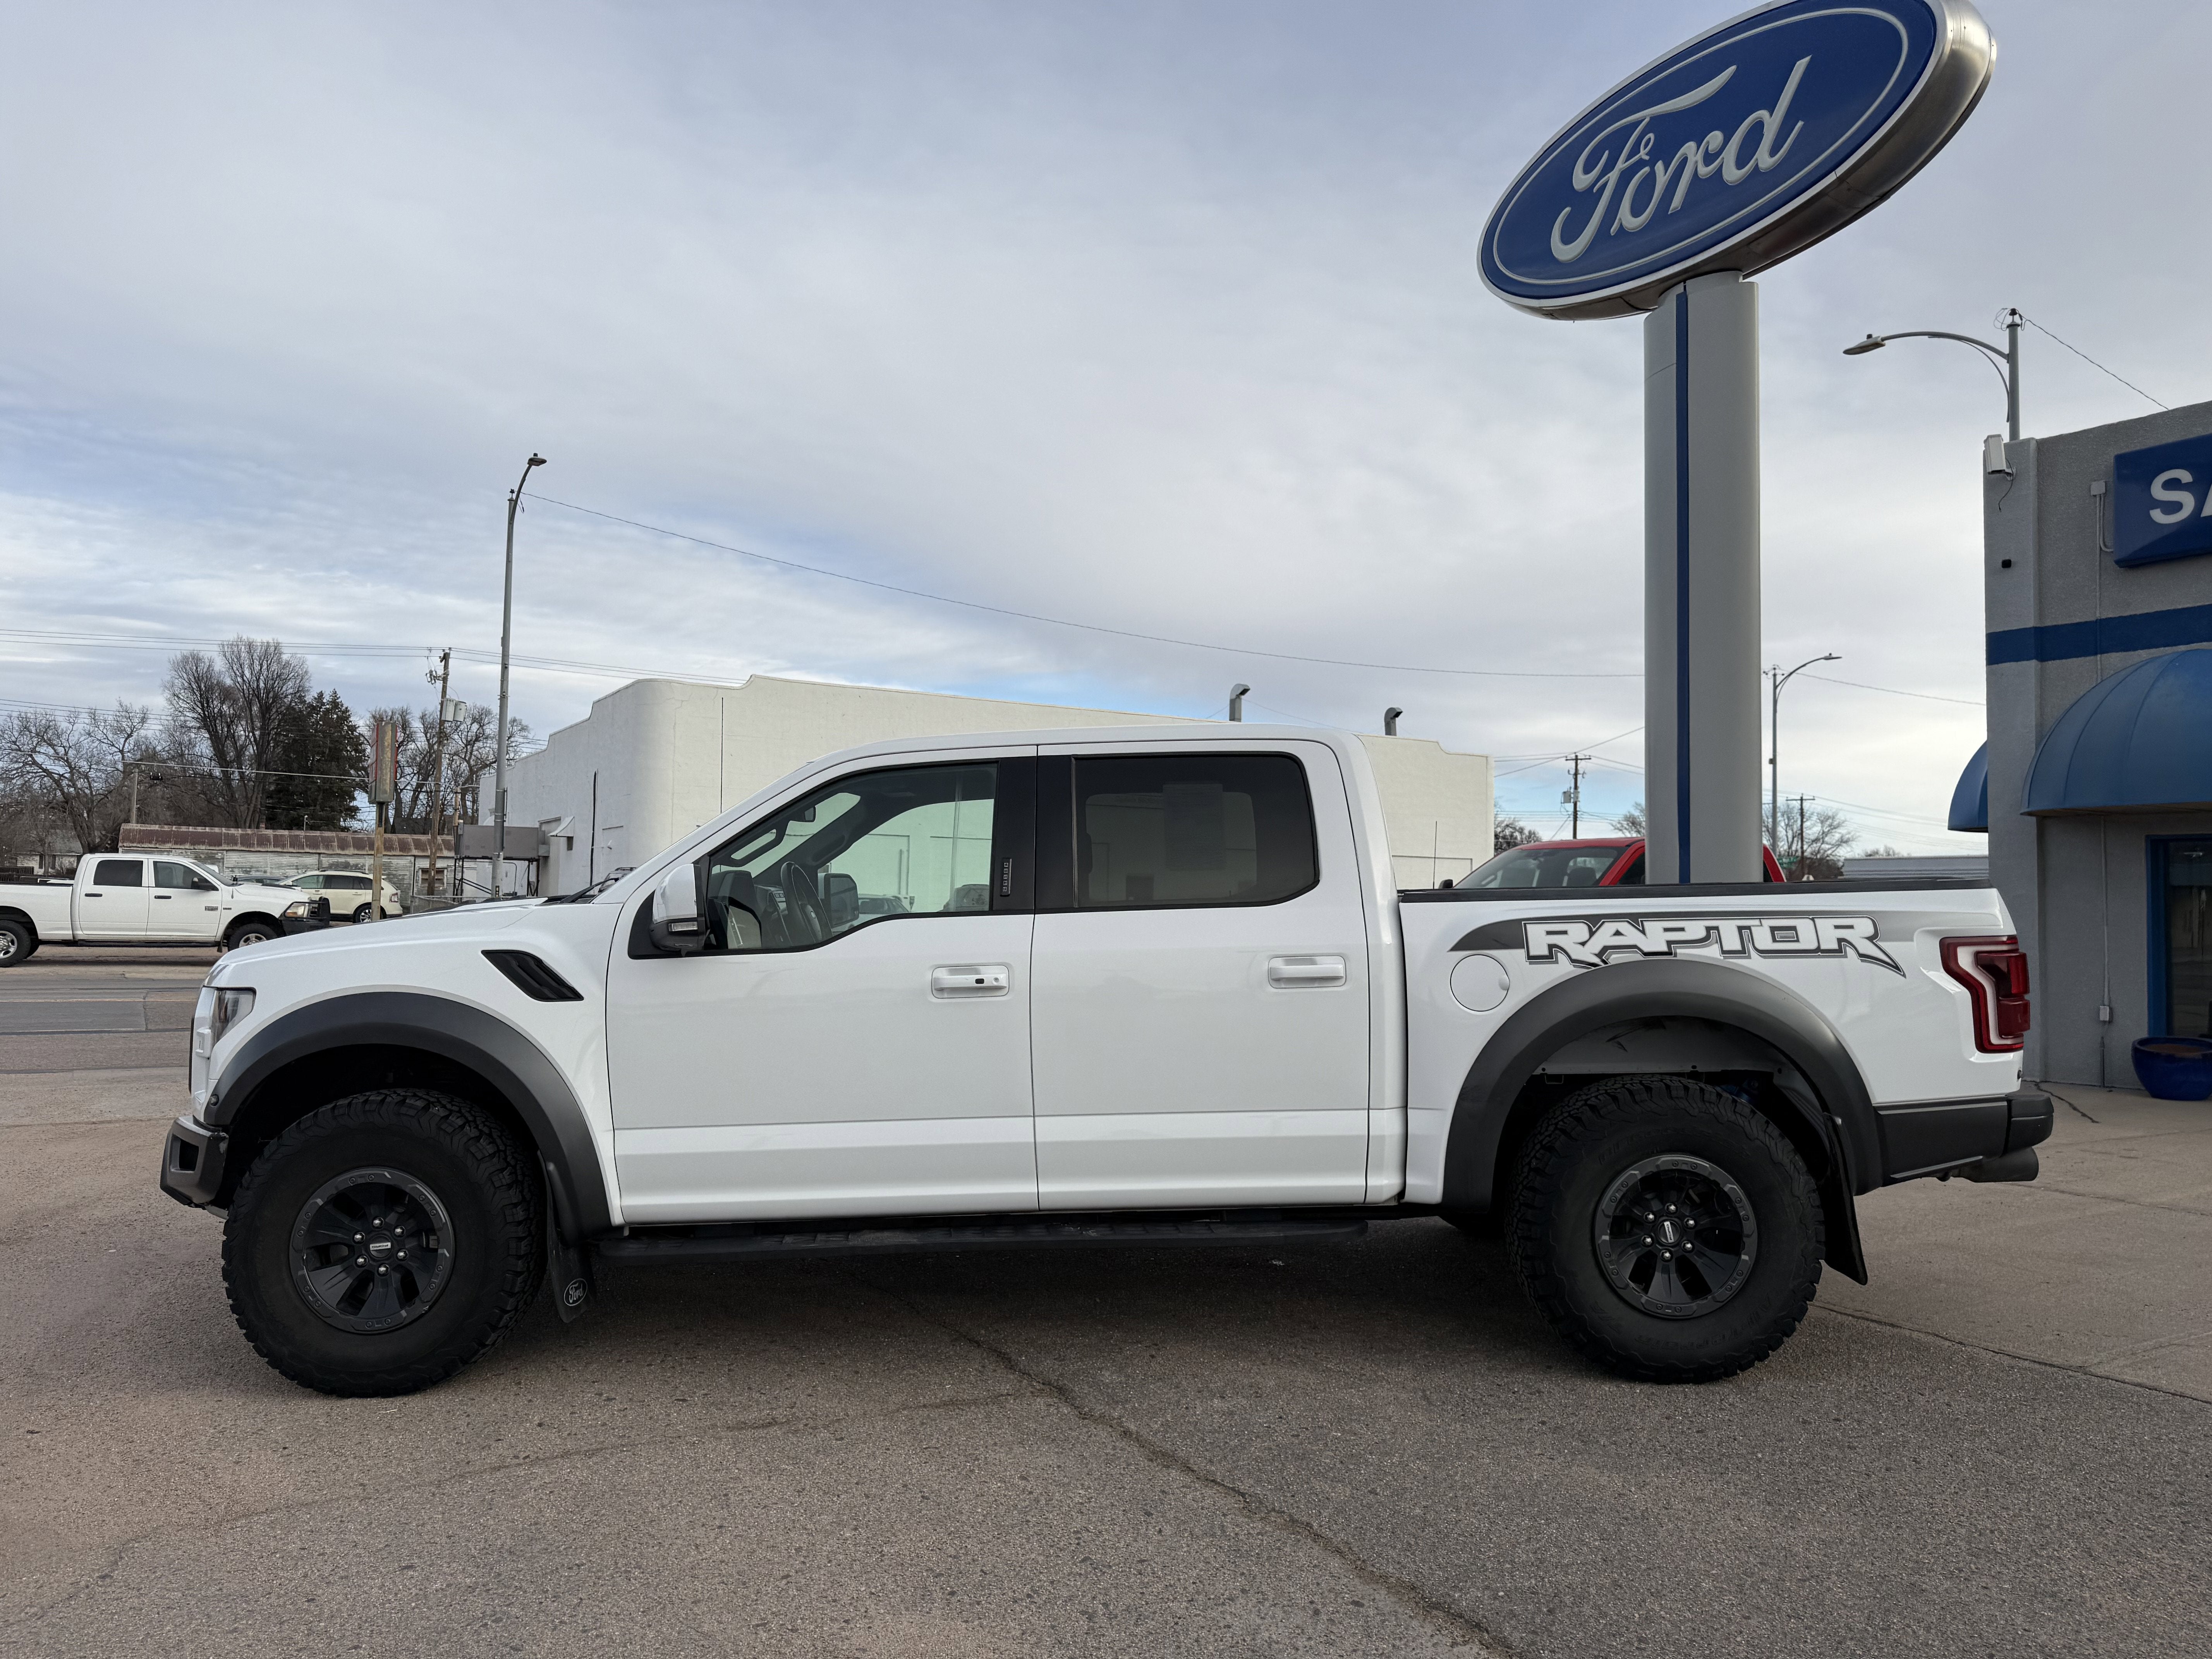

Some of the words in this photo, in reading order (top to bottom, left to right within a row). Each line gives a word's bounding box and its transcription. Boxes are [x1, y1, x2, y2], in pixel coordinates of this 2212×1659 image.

[1551, 55, 1812, 263] Ford
[2149, 469, 2212, 524] S
[1522, 915, 1906, 978] RAPTOR
[569, 1282, 584, 1303] Ford
